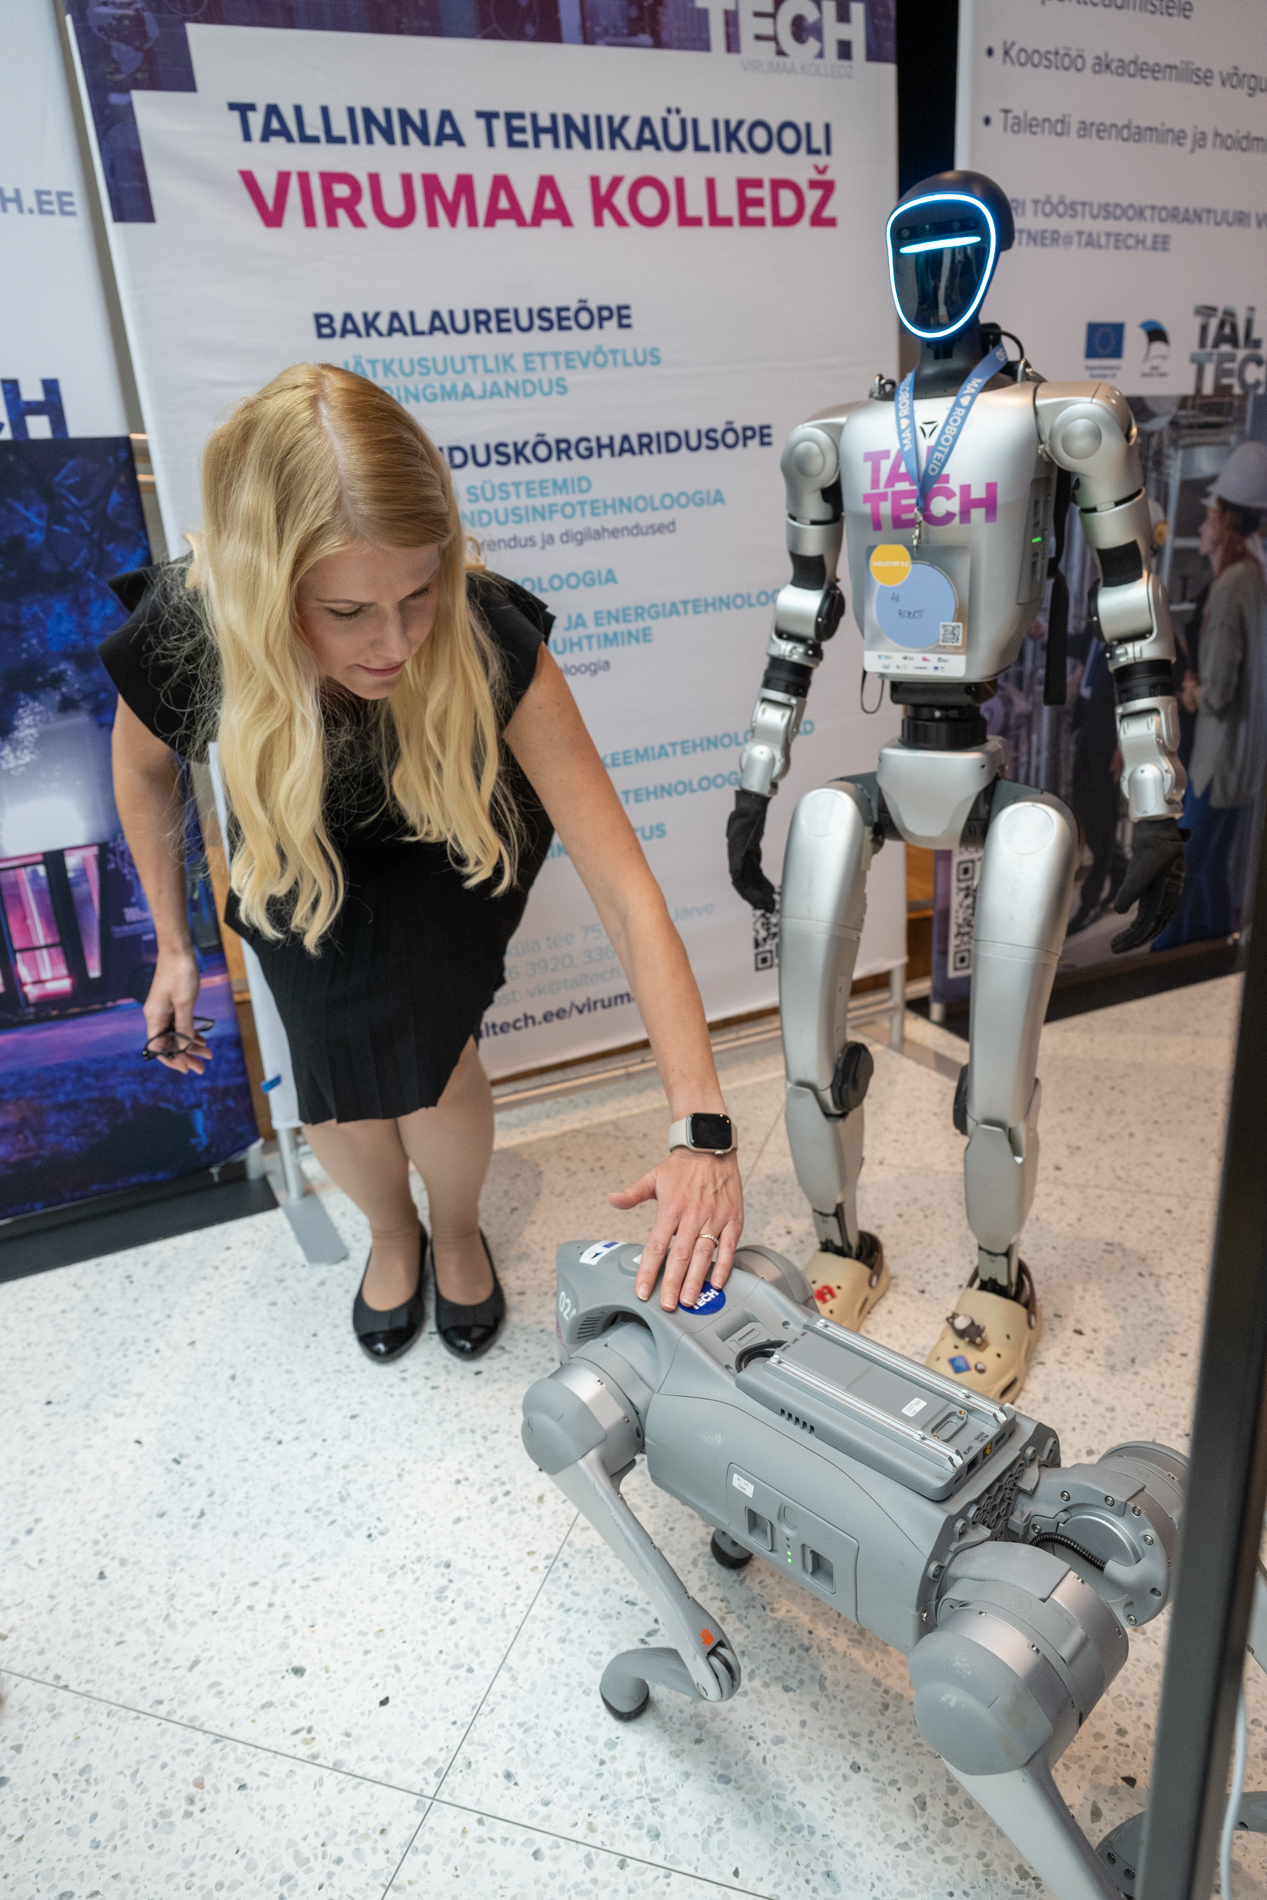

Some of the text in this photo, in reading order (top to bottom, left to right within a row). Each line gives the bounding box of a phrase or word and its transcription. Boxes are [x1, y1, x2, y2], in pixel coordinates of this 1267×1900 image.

[695, 0, 866, 62] TECH
[1002, 40, 1086, 73] Koostöö
[1091, 51, 1214, 88] akadeemilise
[227, 102, 832, 156] TALLINNA TEHNIKAÜLIKOOLI
[1001, 108, 1267, 154] Talendi arendamine ja hoidm
[238, 164, 838, 229] VIRUMAA KOLLEDŽ
[1031, 194, 1251, 228] TÖÖSTUSDOKTORANTUURI
[1014, 228, 1171, 252] TNER@TALTECH.EE
[313, 299, 633, 340] BAKALAUREUSEÕPE
[1193, 304, 1263, 350] TAL
[523, 344, 662, 373] ETTEVÕTLUS
[1190, 351, 1267, 397] TEC
[438, 421, 773, 469] DUSKÕRGHARIDUSÕPE
[927, 377, 983, 476] MA ROBOTEID
[466, 475, 592, 504] SÜSTEEMID
[863, 481, 998, 531] TECH
[540, 530, 555, 550] ja
[559, 519, 677, 547] digilahendused
[515, 567, 618, 594] OLOOGIA
[547, 627, 654, 656] UHTIMINE
[479, 991, 635, 1039] ltech.ee/virum
